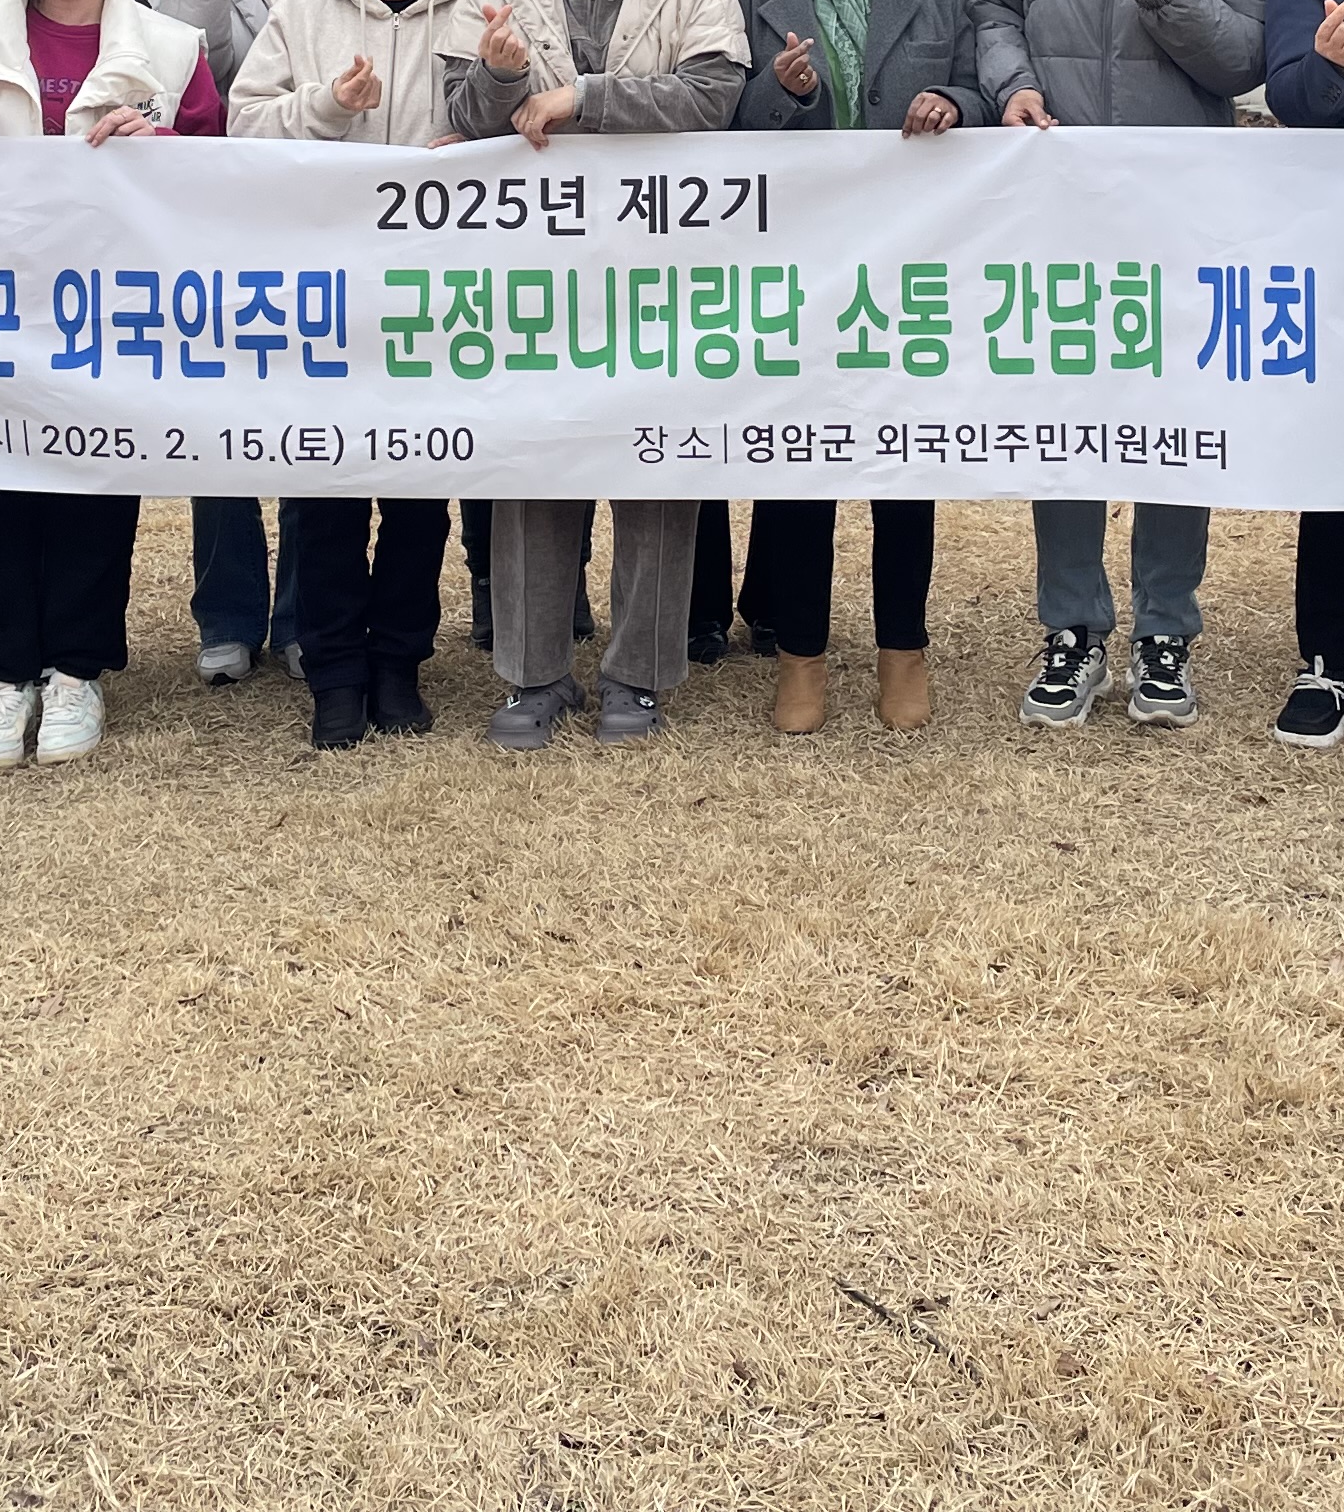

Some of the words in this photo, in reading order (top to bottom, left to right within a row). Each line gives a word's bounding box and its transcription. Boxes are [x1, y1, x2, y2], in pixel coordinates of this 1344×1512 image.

[376, 175, 586, 237] 2025년
[616, 173, 768, 235] 제2기
[50, 268, 349, 380] 외국인주민
[380, 263, 805, 380] 군정모니터링단
[836, 262, 953, 378] 소통
[983, 261, 1163, 378] 간담회
[1196, 265, 1316, 384] 개최
[165, 428, 199, 461] 2.
[219, 424, 345, 466] 15.(토)
[364, 427, 474, 462] 15:00
[875, 422, 1228, 470] 외국인주민지원센터
